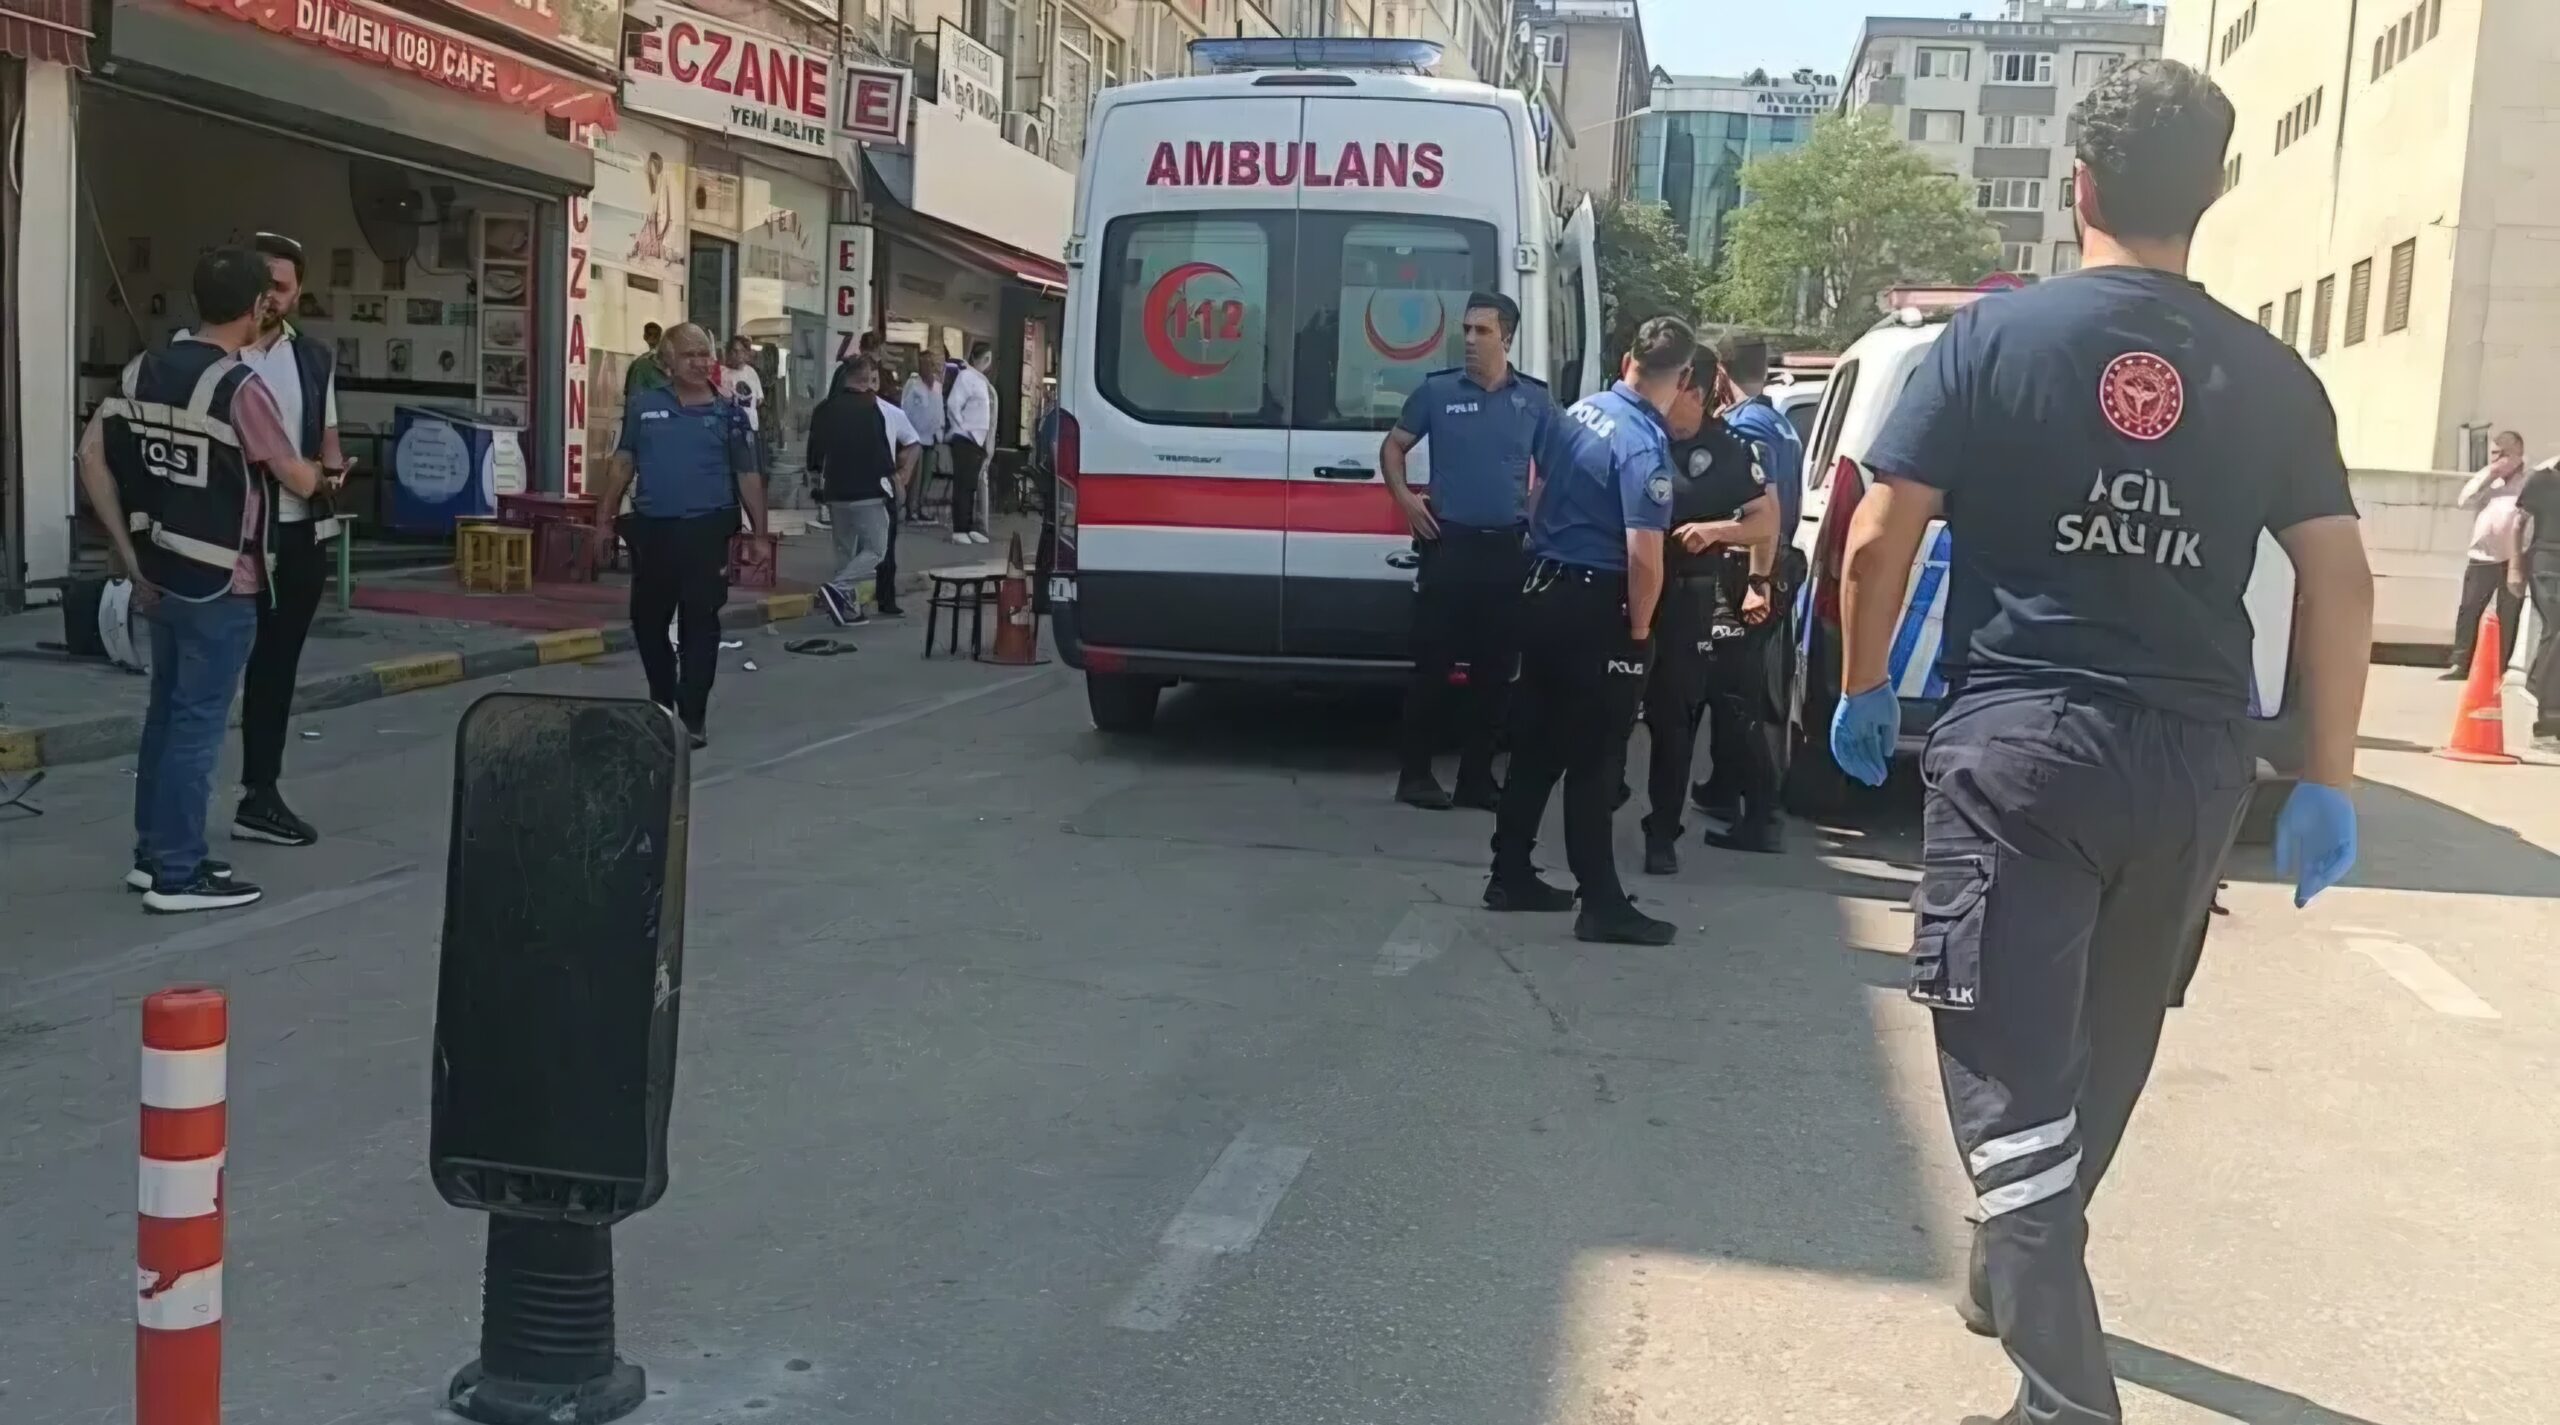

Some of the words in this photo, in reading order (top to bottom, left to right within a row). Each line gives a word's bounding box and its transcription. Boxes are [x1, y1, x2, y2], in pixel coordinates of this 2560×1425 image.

[396, 24, 436, 69] (08)
[442, 46, 497, 89] CAFE
[632, 21, 827, 119] ECZANE
[1146, 142, 1444, 189] AMBULANS
[569, 122, 589, 499] CZANE
[1167, 298, 1244, 340] 112
